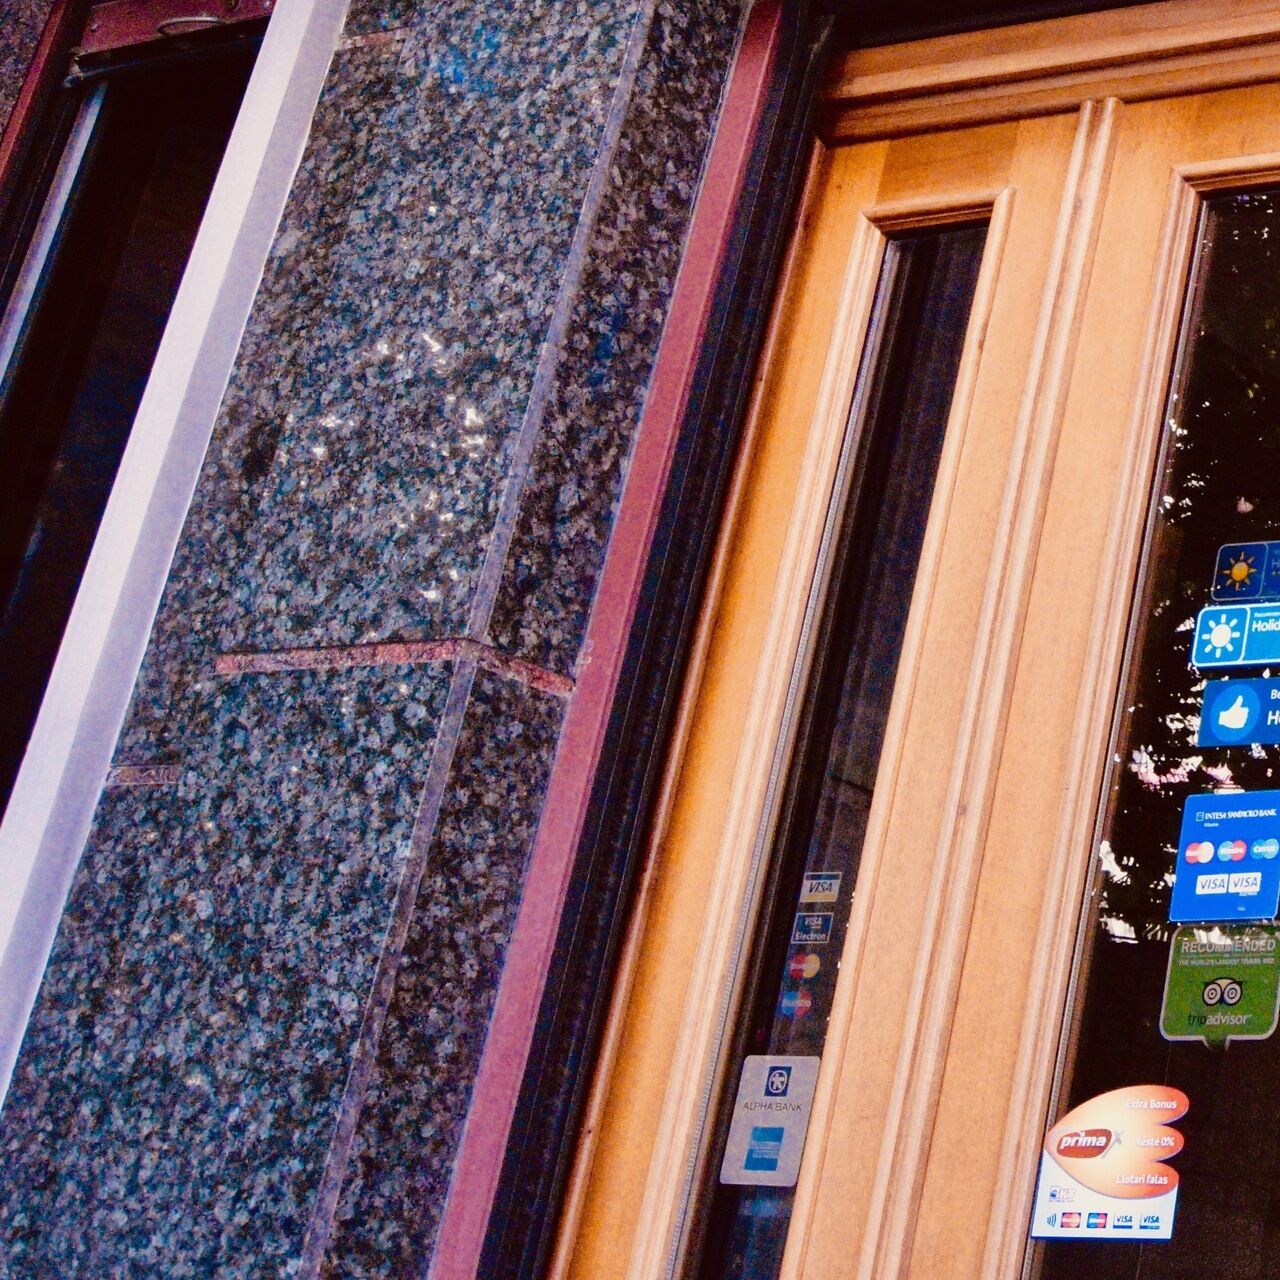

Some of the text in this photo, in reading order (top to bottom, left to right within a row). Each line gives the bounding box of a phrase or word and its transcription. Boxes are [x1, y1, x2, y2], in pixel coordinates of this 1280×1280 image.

[1259, 808, 1278, 817] BANK
[808, 881, 833, 894] VISA
[1200, 877, 1258, 890] VISA VISA
[796, 930, 826, 941] Electron
[1181, 938, 1277, 953] RECOMMENDED
[1188, 1012, 1250, 1027] tripadvisor
[743, 1101, 802, 1112] ALPHA BANK
[1126, 1099, 1177, 1110] Extra Bonus
[1060, 1130, 1107, 1149] prima
[1161, 1136, 1175, 1147] 0%
[1145, 1175, 1168, 1185] falas
[1116, 1215, 1133, 1224] VISA
[1143, 1215, 1160, 1224] VISA
